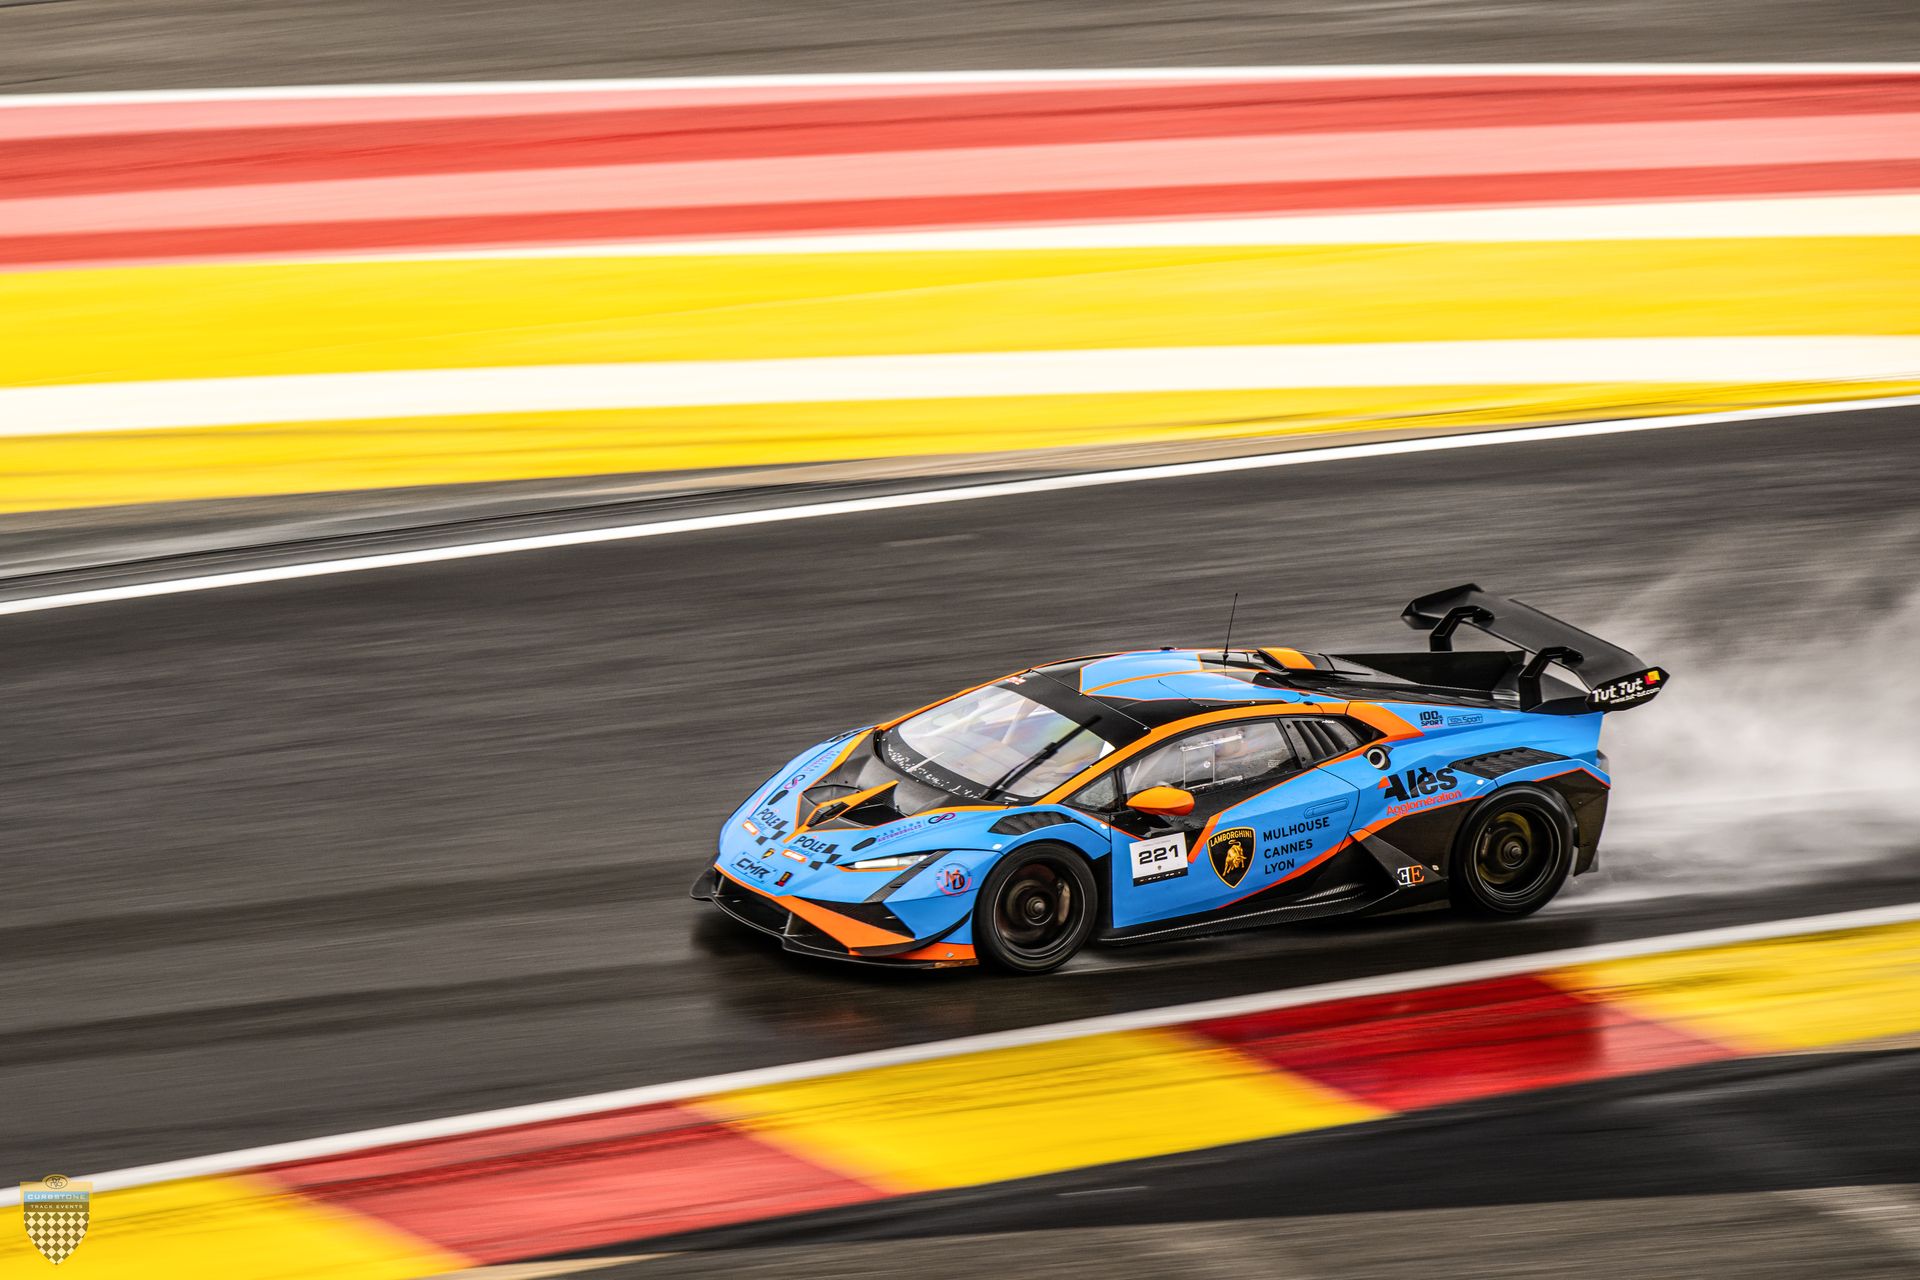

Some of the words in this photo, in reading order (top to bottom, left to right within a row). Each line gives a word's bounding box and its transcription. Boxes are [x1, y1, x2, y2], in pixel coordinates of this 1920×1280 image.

[1592, 685, 1617, 703] Tut
[1618, 678, 1643, 695] Tut
[1421, 719, 1443, 727] SPORT
[1378, 767, 1459, 802] Alès
[1386, 790, 1463, 816] Agglomération
[1210, 830, 1253, 847] LAMBORGHINI
[1263, 816, 1330, 842] MULHOUSE
[1138, 844, 1179, 865] 221
[1264, 838, 1314, 859] CANNES
[735, 857, 771, 880] CMR
[1264, 859, 1295, 875] LYON
